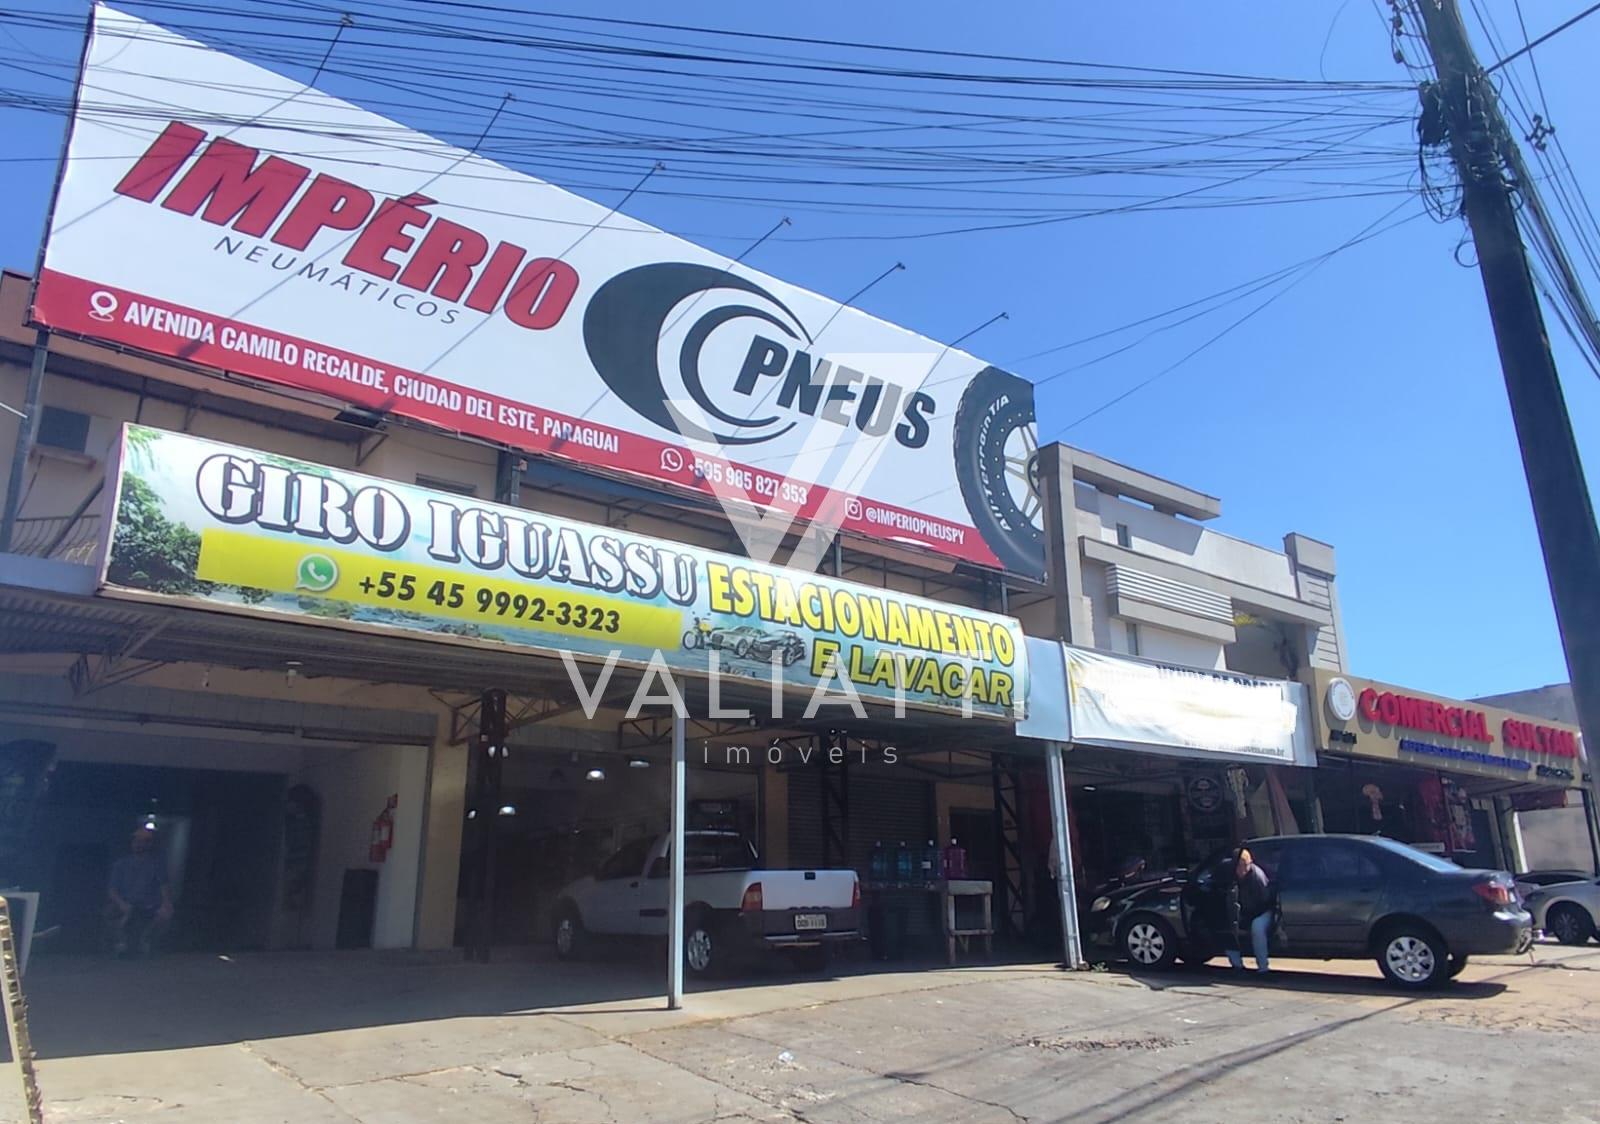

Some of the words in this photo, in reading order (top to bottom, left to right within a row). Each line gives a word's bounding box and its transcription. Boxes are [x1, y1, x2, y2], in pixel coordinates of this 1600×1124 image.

[113, 120, 581, 331] IMPÉRIO
[213, 235, 460, 325] NEUMÁTICOS
[123, 302, 216, 345] AVENIDA
[220, 326, 299, 366] CAMILO
[302, 348, 390, 394] RECALDE,
[393, 374, 462, 411] CIUDAD
[464, 395, 495, 421] DEL
[498, 404, 540, 436] ESTE,
[542, 416, 620, 454] PARAGUAI
[733, 334, 936, 450] PNEUS
[197, 454, 411, 552] GIRO
[428, 500, 698, 607] IGUASSU
[726, 466, 752, 491] 985
[755, 476, 778, 497] 827
[782, 483, 808, 506] 353
[865, 508, 966, 546] @IMPERIOPNEUSPY
[359, 570, 417, 603] +55
[427, 580, 465, 609] 45
[476, 588, 621, 634] 9992-3323
[707, 560, 1015, 668] ESTACIONAMENTO
[811, 638, 841, 680] E
[849, 642, 1015, 707] LAVACAR
[1501, 717, 1579, 760] SULTAN
